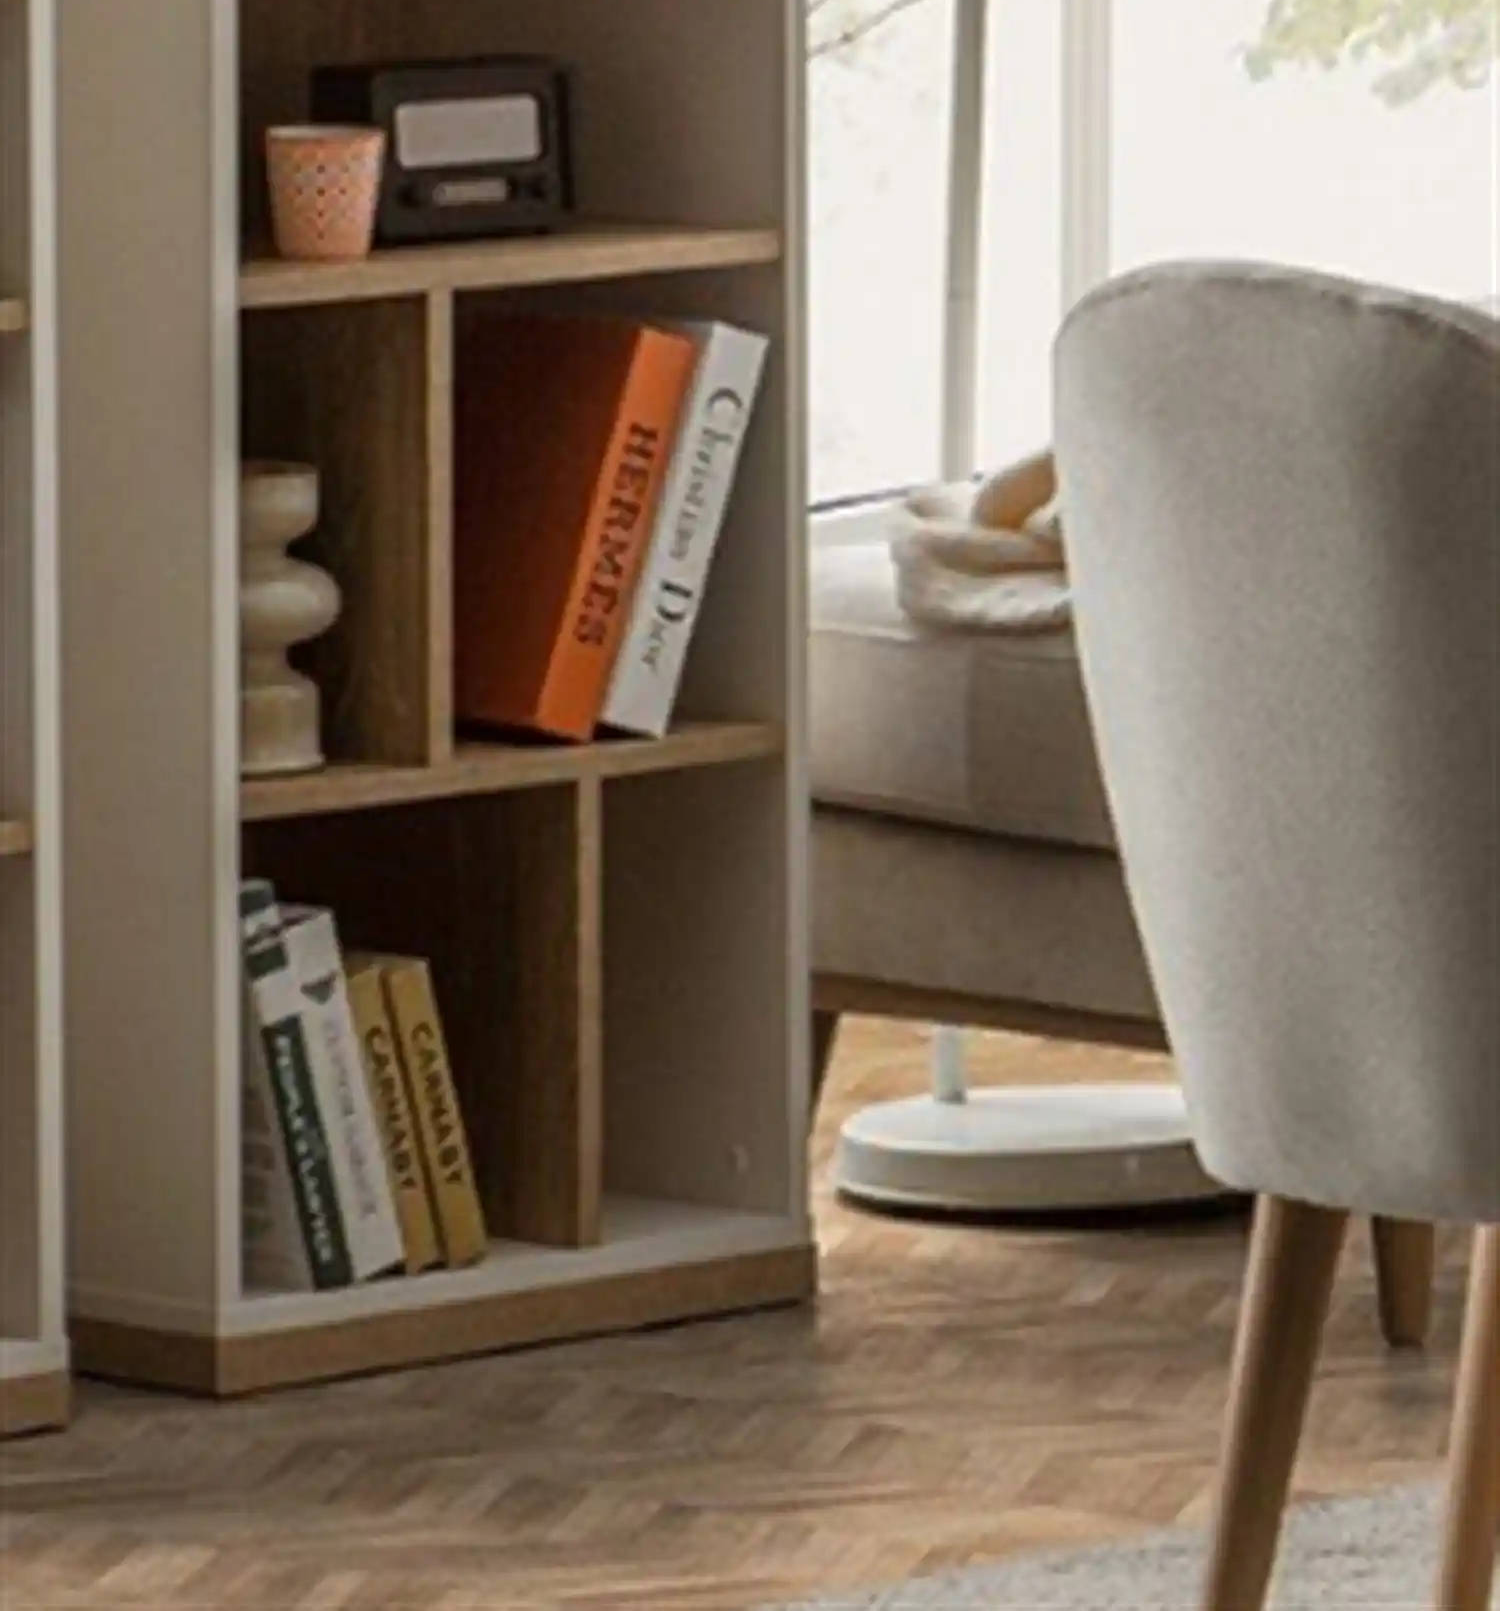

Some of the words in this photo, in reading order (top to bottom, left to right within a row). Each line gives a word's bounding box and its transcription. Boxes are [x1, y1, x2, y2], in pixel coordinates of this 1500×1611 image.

[667, 387, 744, 562] Christian
[638, 579, 693, 674] Dior
[409, 1020, 463, 1186] CARNABY
